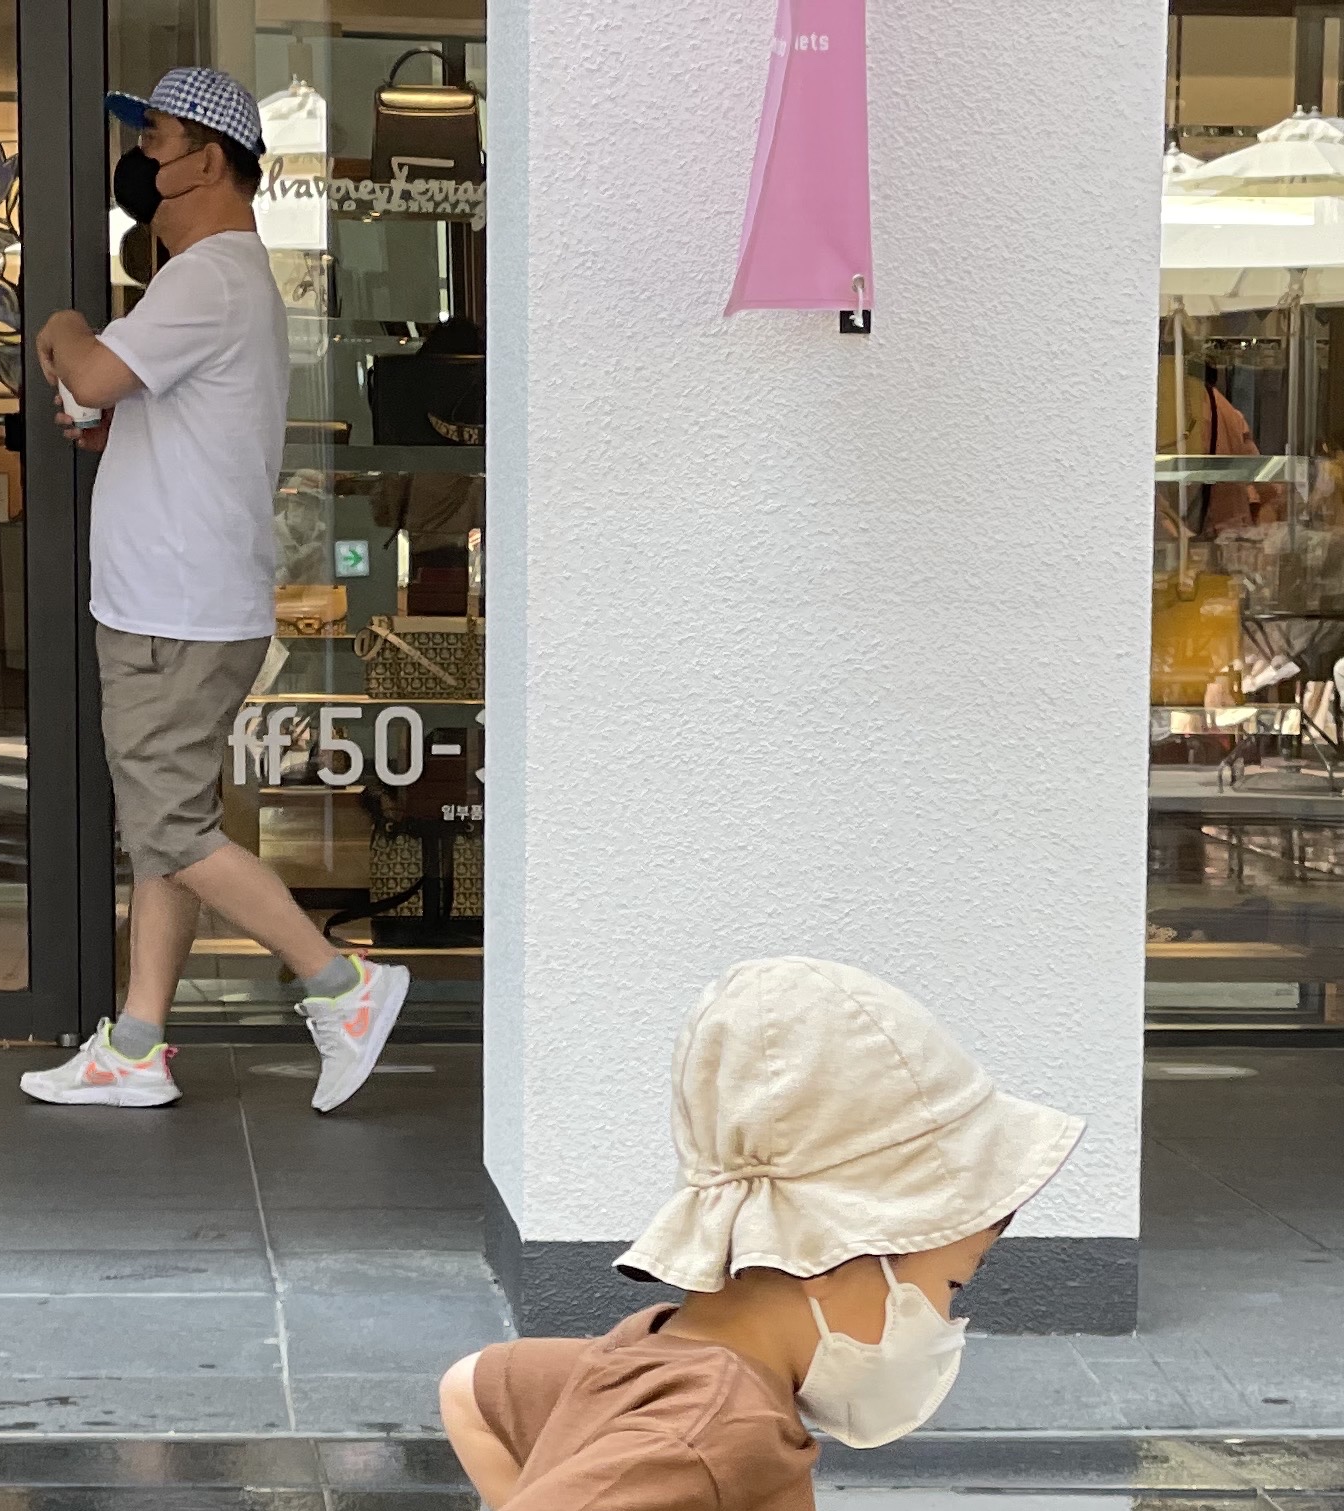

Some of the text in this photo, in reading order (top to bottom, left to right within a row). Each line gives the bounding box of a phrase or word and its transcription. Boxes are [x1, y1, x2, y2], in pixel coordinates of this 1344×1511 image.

[256, 156, 376, 202] lvatore
[228, 705, 485, 787] ff 50-
[441, 803, 484, 822] 일부품
